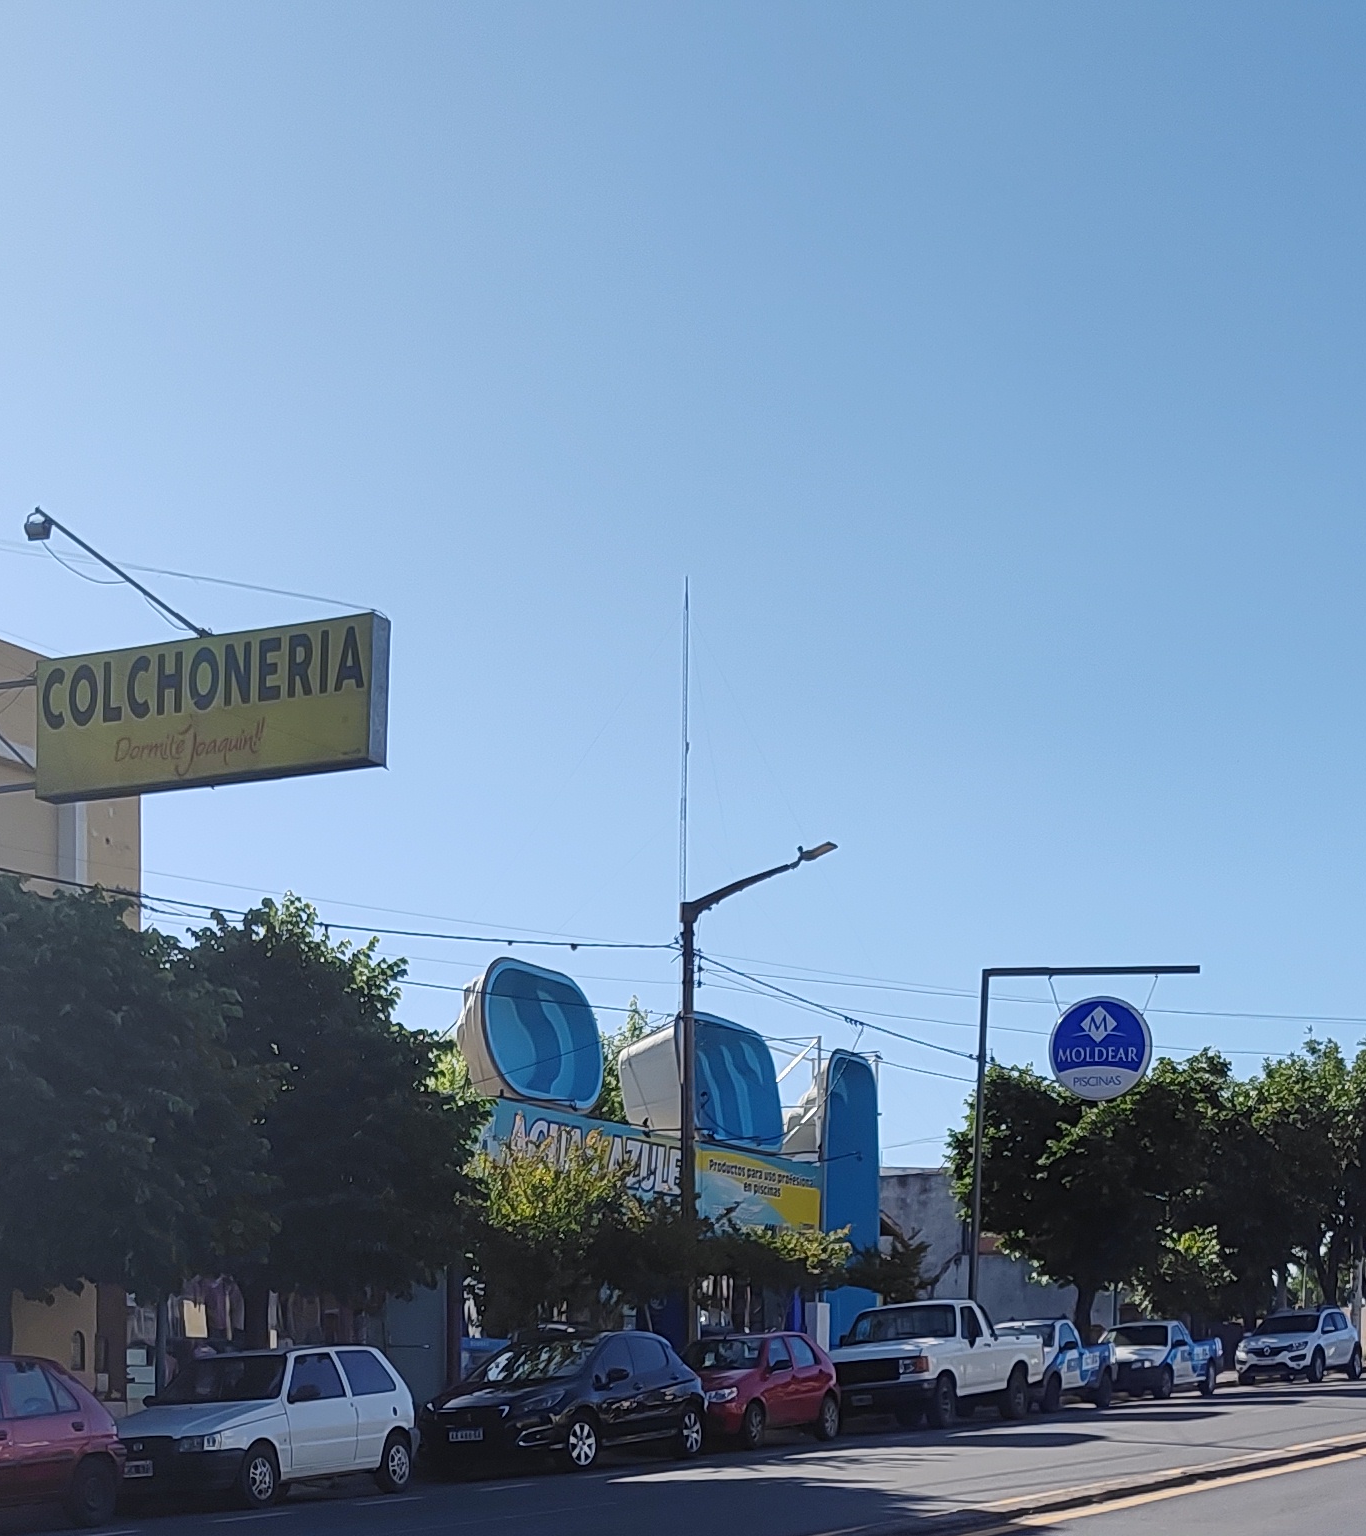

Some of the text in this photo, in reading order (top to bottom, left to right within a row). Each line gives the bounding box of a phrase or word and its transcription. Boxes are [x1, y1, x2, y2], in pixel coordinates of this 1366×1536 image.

[41, 625, 365, 730] COLCHONERIA
[1088, 1013, 1108, 1032] M
[1057, 1047, 1139, 1063] MOLDEAR
[1073, 1075, 1122, 1087] PISCINAS
[709, 1159, 814, 1188] Productos para uso profesiona
[754, 1183, 781, 1198] piscinas
